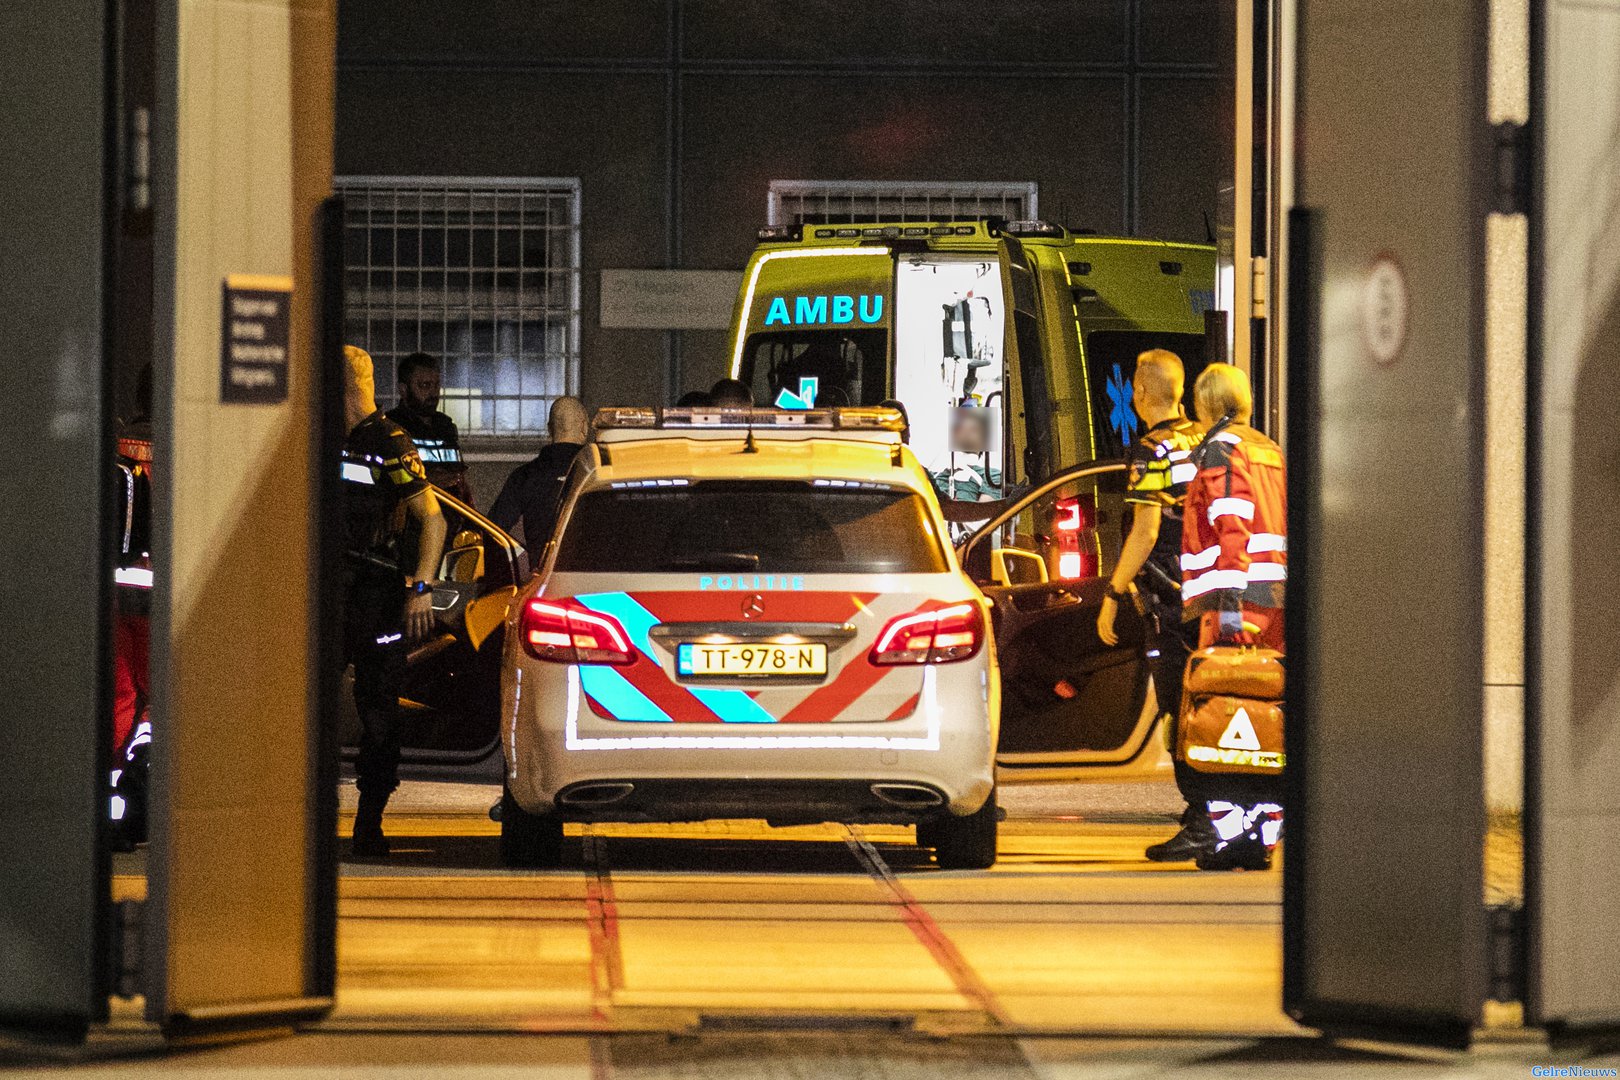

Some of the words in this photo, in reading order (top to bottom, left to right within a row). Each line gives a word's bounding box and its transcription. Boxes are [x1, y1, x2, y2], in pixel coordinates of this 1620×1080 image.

[765, 295, 883, 325] AMBU
[700, 575, 804, 590] POLITIE
[702, 648, 813, 669] TT-978-N
